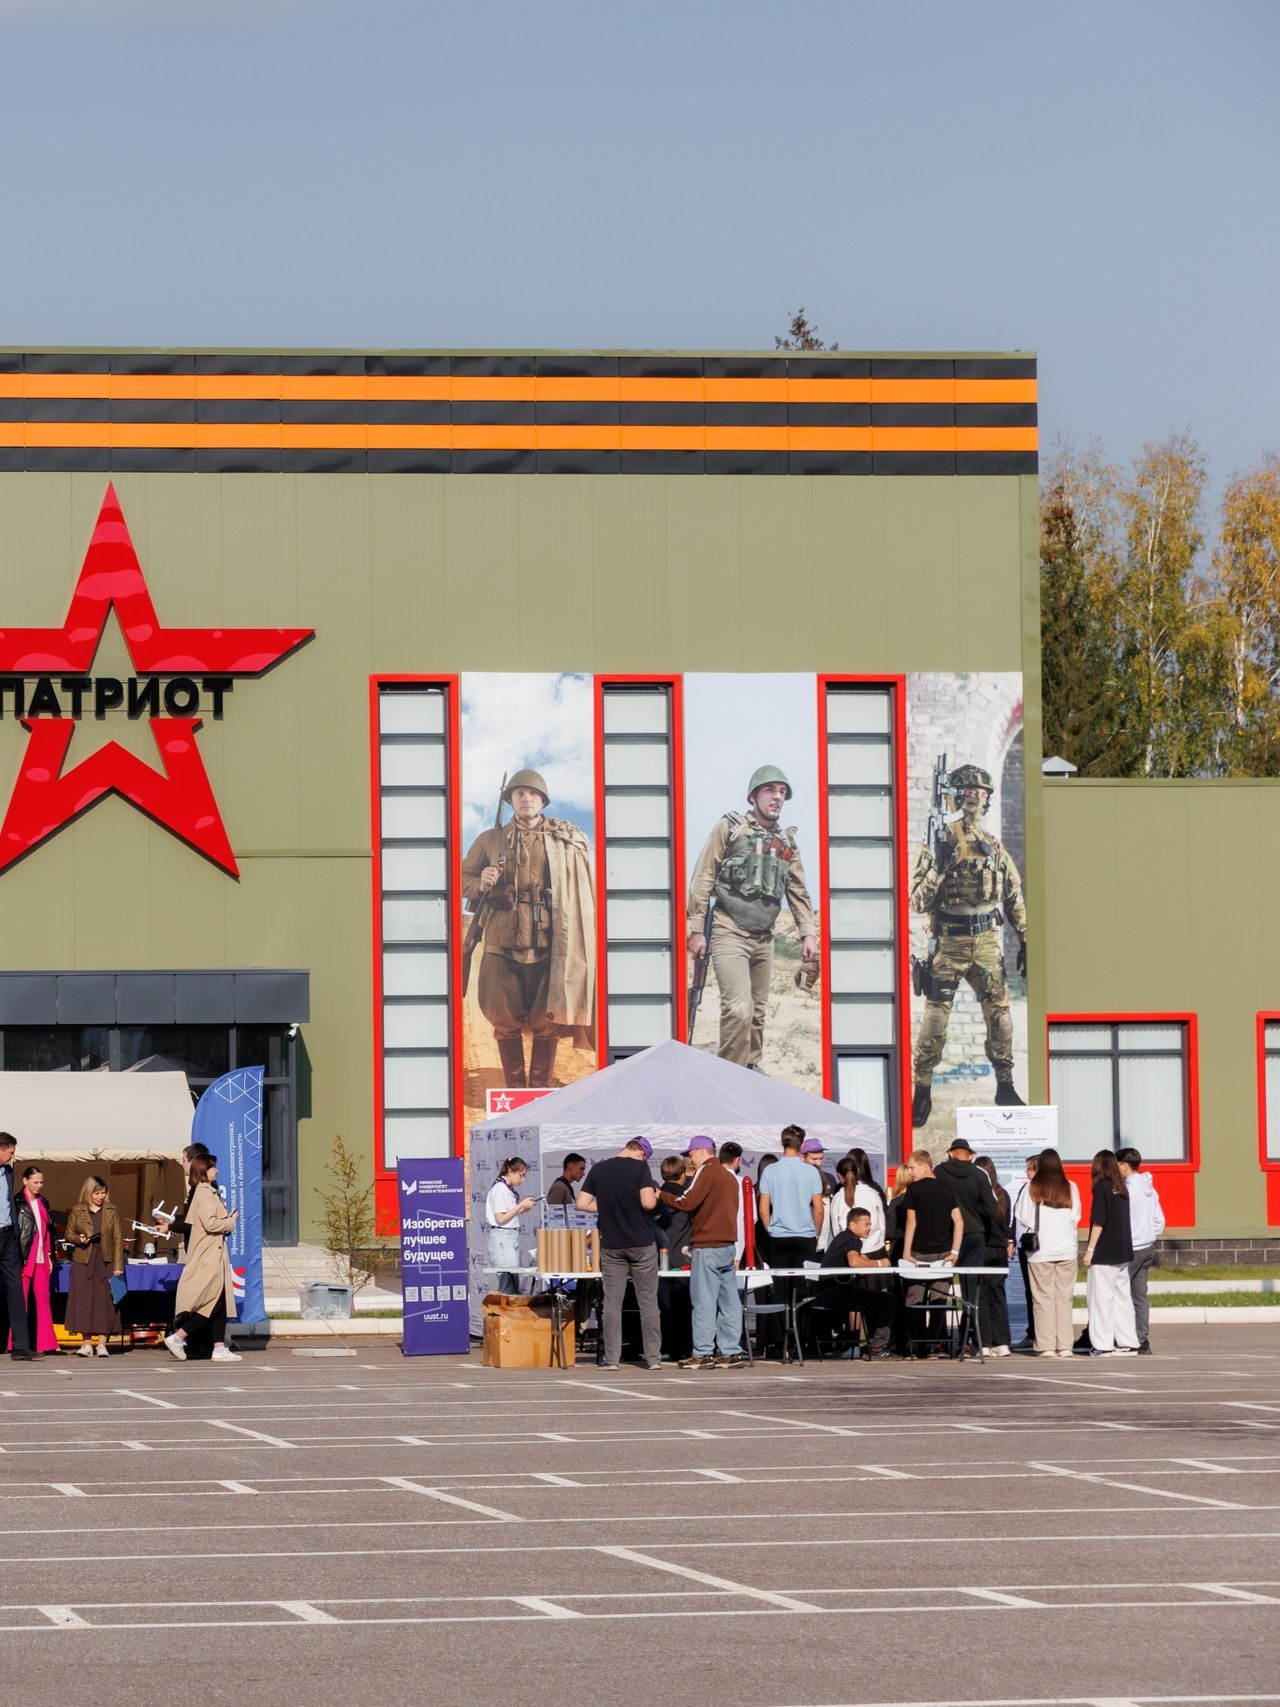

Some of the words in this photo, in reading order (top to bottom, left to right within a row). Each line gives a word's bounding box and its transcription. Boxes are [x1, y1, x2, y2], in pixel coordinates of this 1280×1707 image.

[402, 1218, 464, 1231] Изобретая
[230, 1231, 238, 1256] Уфимс
[403, 1235, 447, 1247] лучшее
[403, 1250, 454, 1263] будущее
